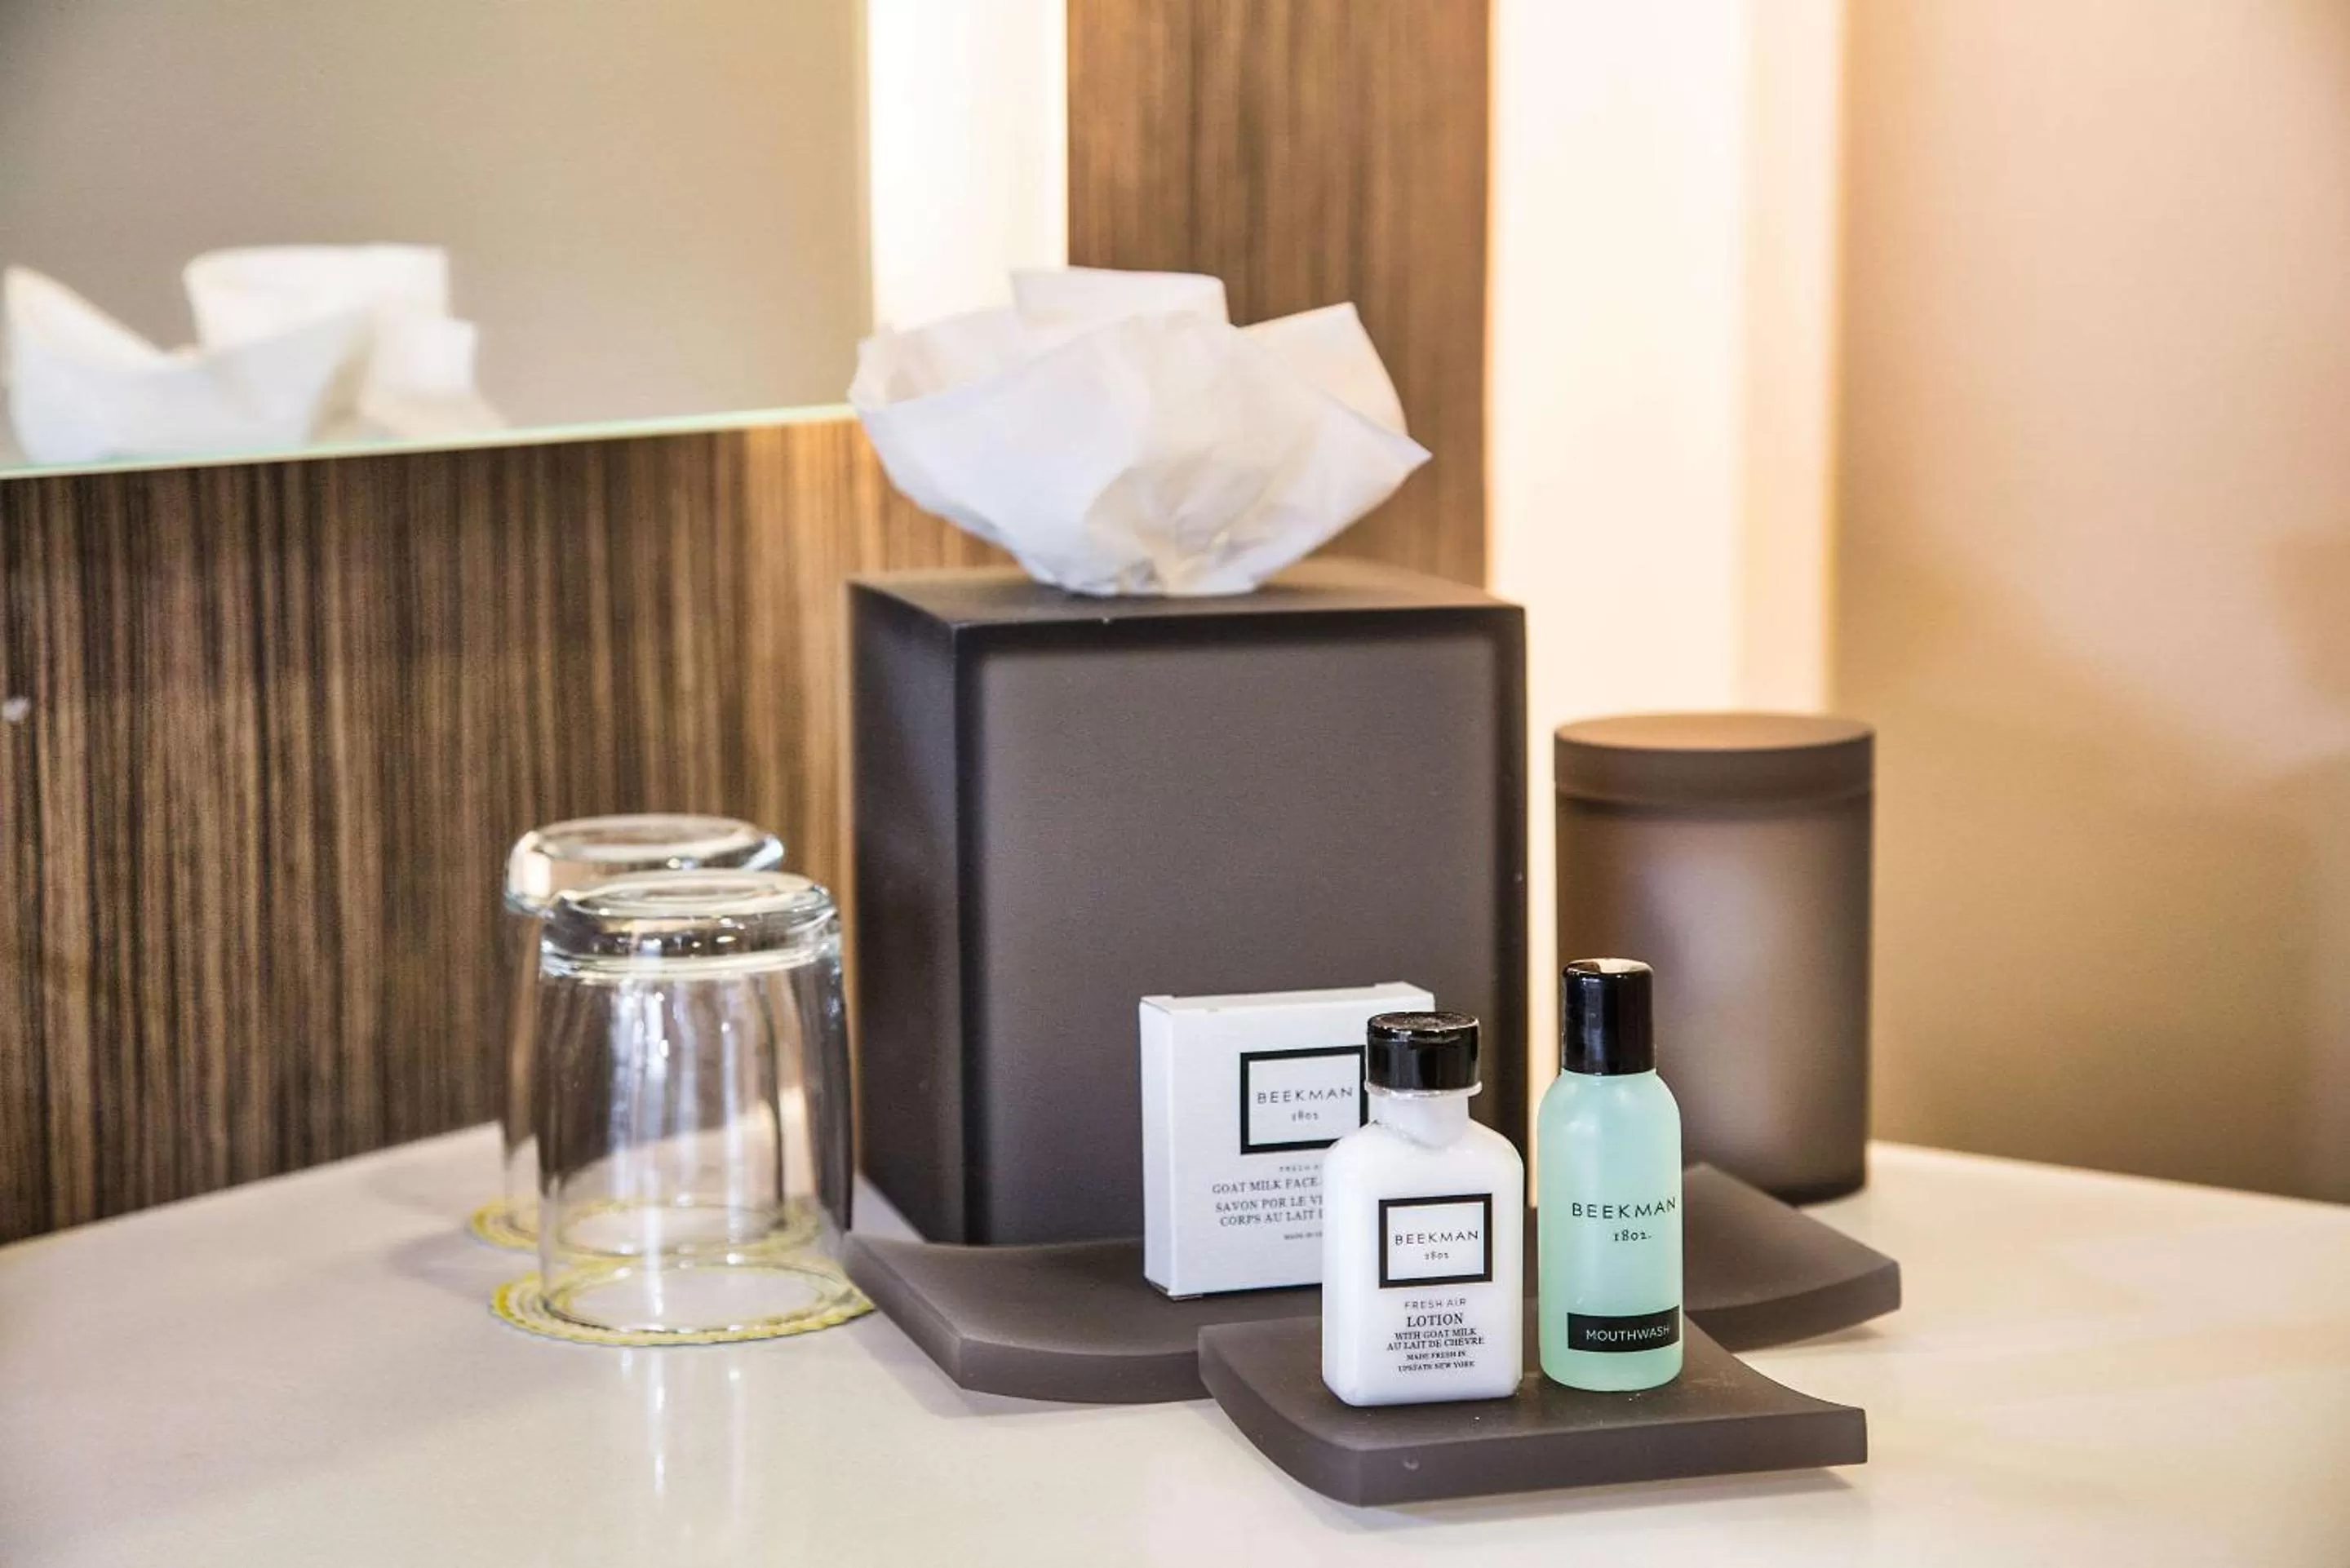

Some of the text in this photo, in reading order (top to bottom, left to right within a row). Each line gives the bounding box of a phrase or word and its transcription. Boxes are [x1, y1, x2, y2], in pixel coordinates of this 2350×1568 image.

[1257, 1087, 1354, 1104] BEEKMAN
[1212, 1177, 1318, 1194] GOAT MILK FACE
[1215, 1200, 1257, 1212] SAVON
[1290, 1196, 1306, 1207] LE
[1572, 1197, 1676, 1220] BEEKMAN
[1220, 1214, 1261, 1226] CORPS
[1265, 1211, 1283, 1223] AU
[1286, 1210, 1315, 1221] LAIT
[1394, 1229, 1479, 1246] BEEKMAN
[1404, 1298, 1466, 1309] FRESH AIR
[1407, 1313, 1464, 1327] LOTION
[1394, 1327, 1477, 1340] WITH GOAT MILK
[1585, 1325, 1670, 1342] MOUTHWASH
[1386, 1342, 1402, 1351] AU
[1403, 1340, 1426, 1349] LAIT
[1428, 1338, 1442, 1348] DE
[1453, 1360, 1475, 1369] YORK
